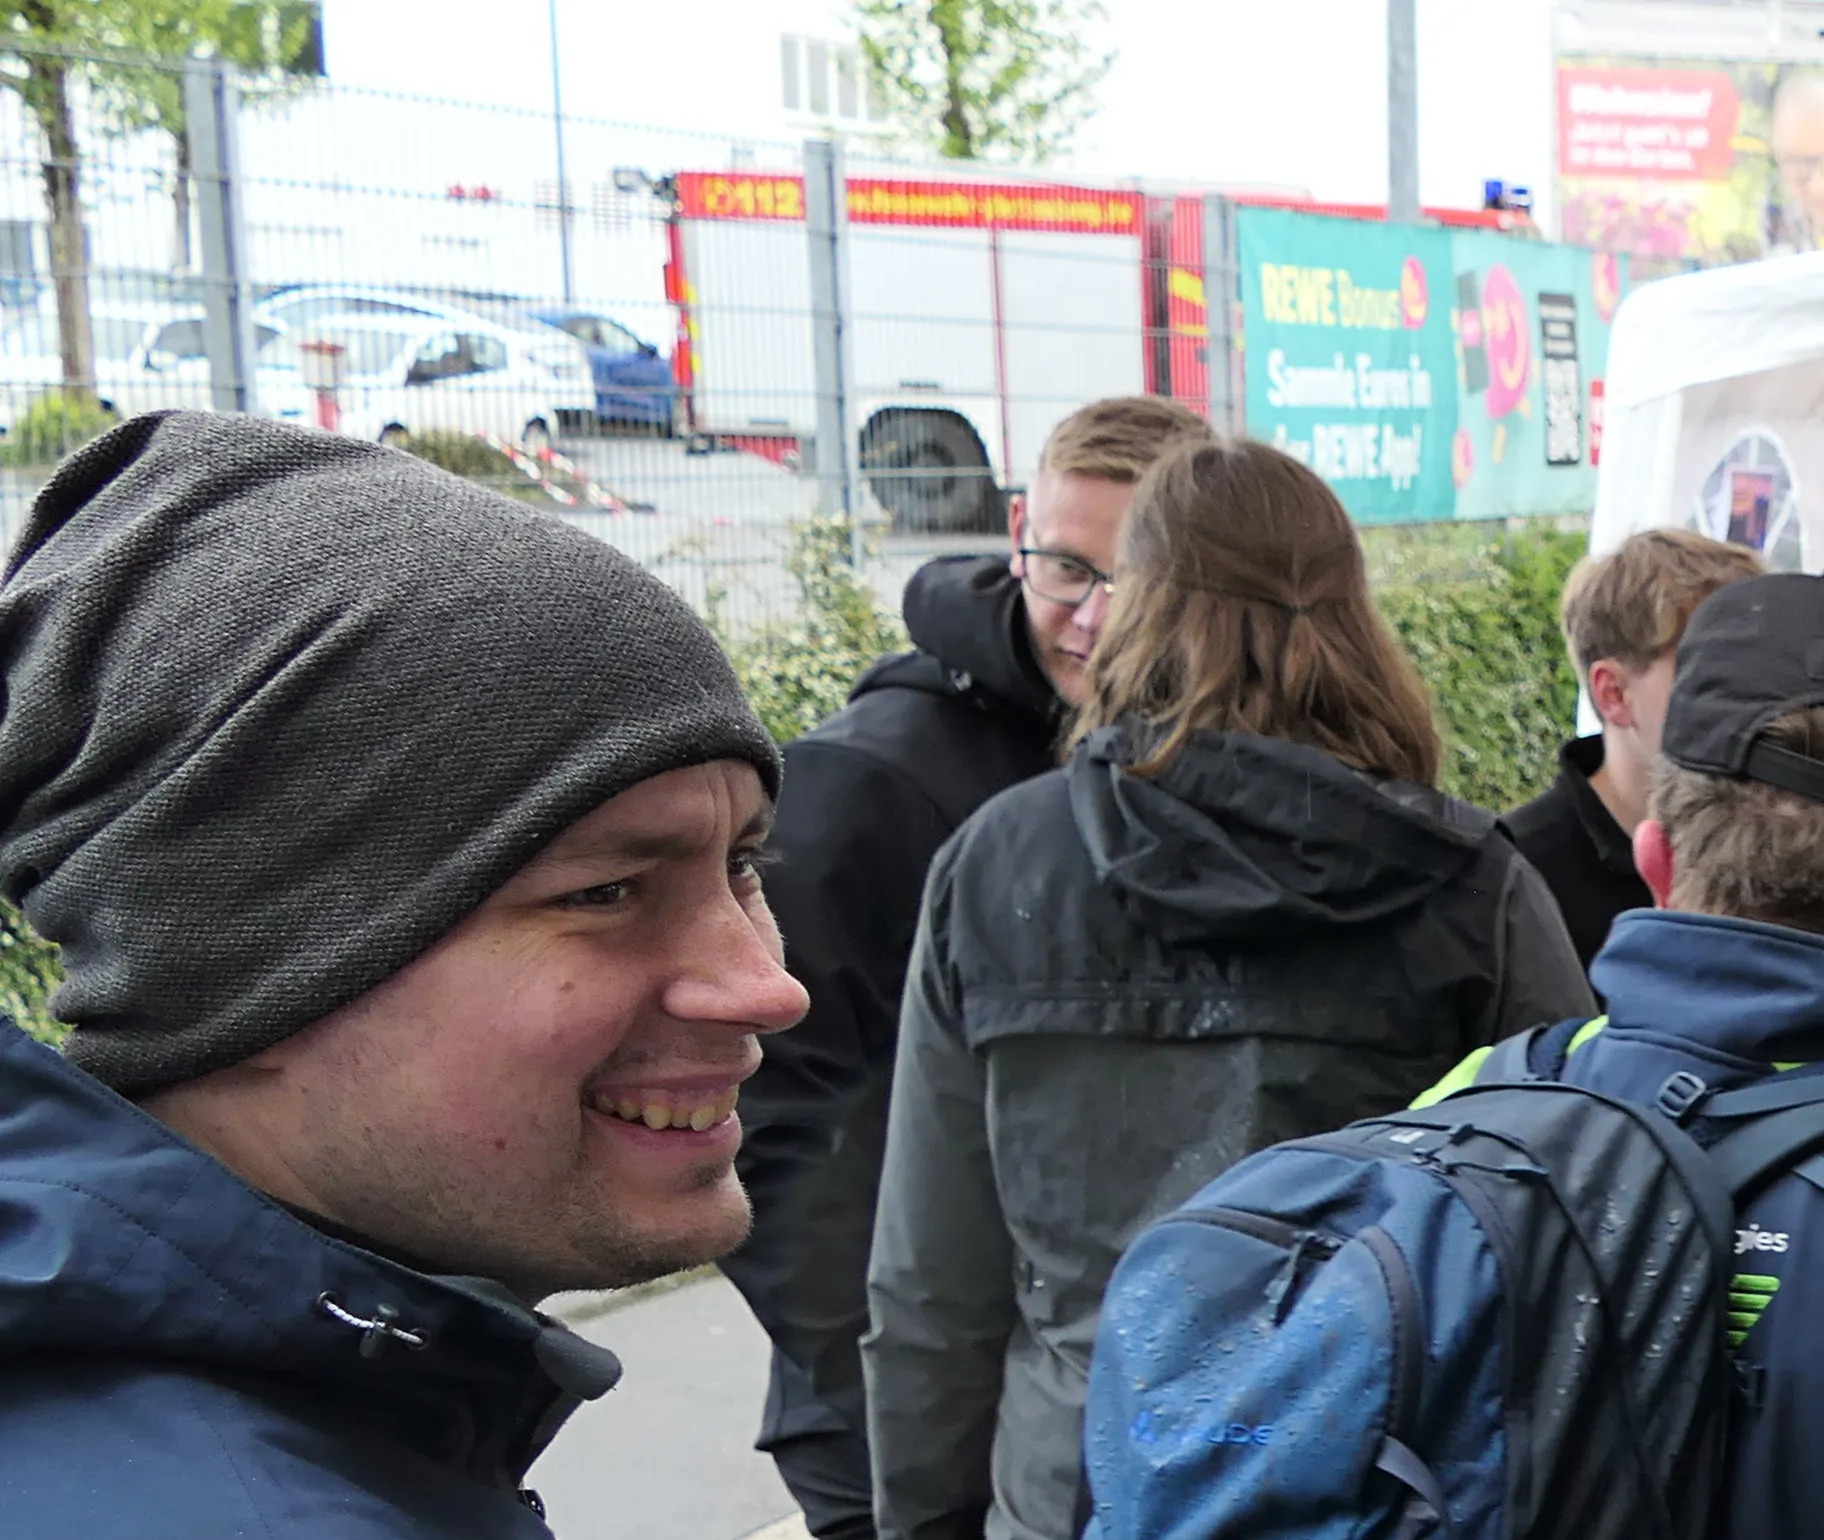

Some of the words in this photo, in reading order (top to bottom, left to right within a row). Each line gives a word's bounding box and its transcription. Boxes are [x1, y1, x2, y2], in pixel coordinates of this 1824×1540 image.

[736, 178, 800, 218] 112
[1261, 263, 1335, 326] REWE
[1312, 424, 1380, 479] REWE
